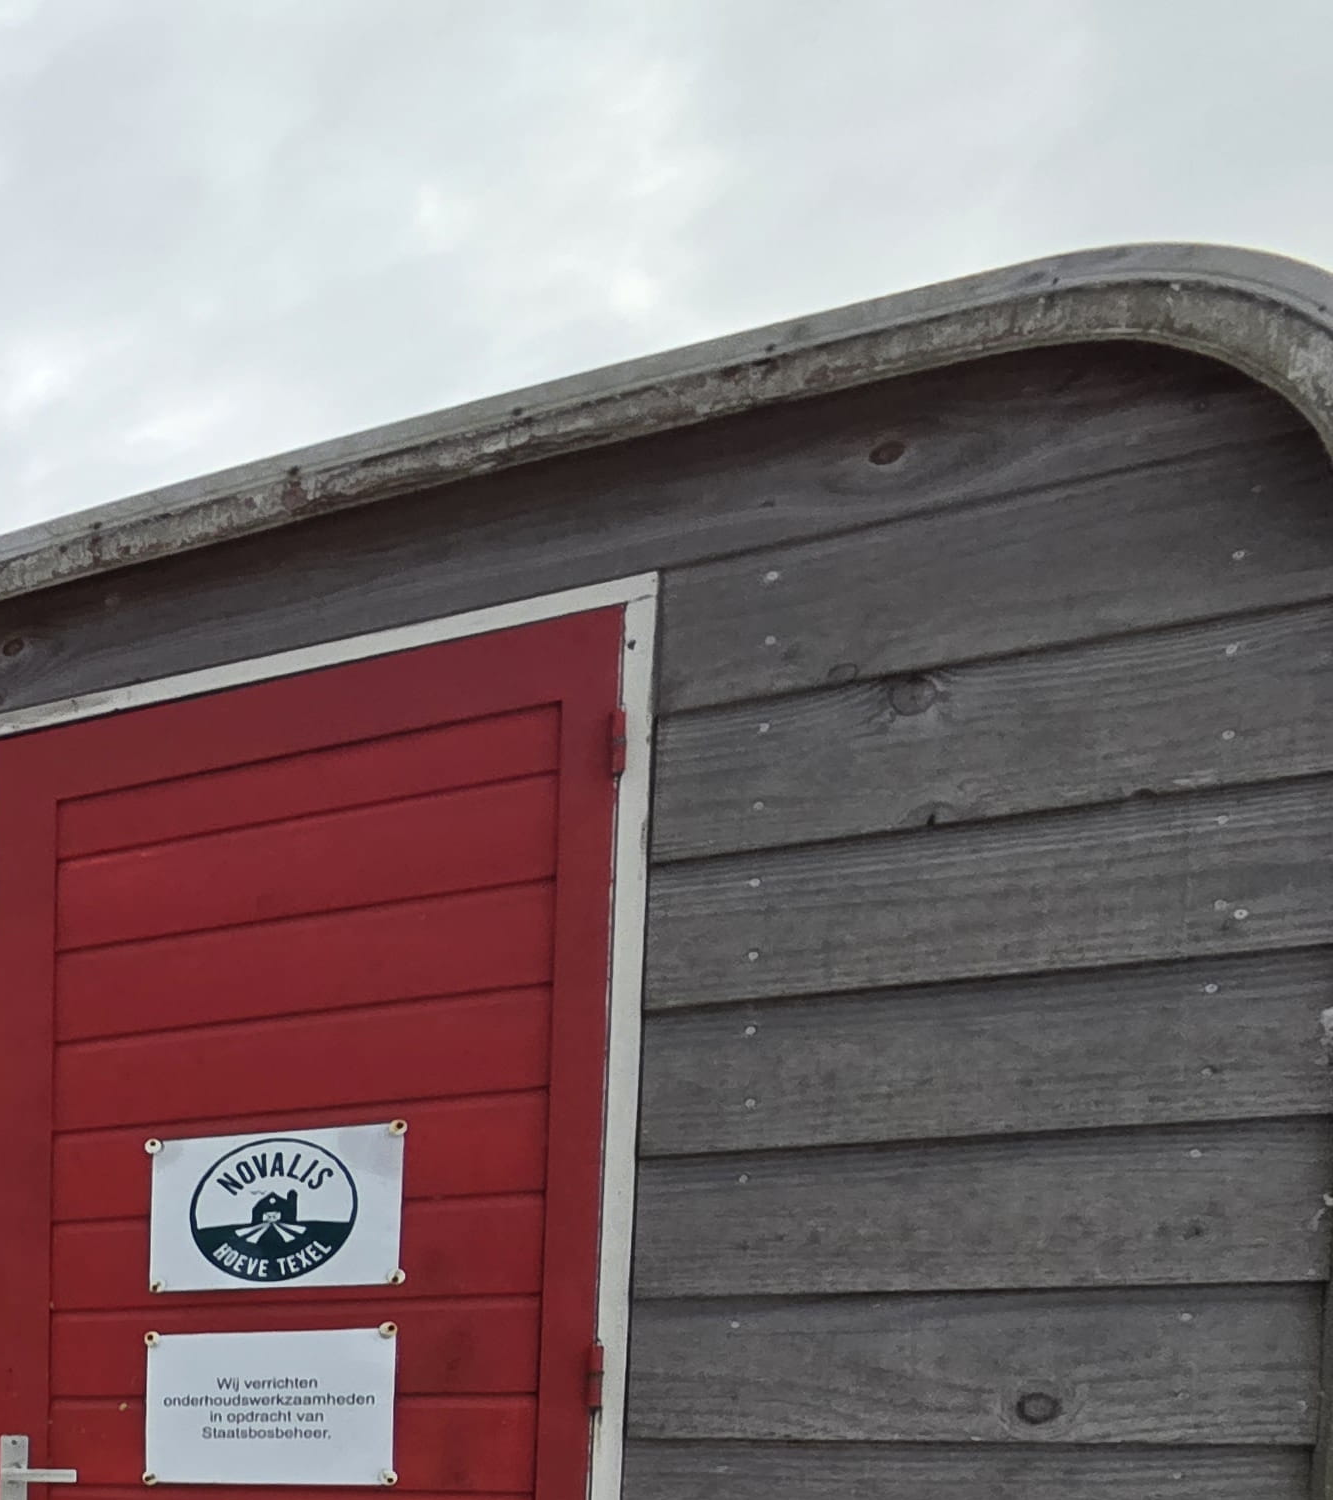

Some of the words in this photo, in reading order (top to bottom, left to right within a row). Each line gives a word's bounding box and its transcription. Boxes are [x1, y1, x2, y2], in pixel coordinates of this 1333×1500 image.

[217, 1152, 334, 1195] NOVALIS
[213, 1242, 268, 1278] HOEVE
[277, 1240, 332, 1276] TEXEL
[217, 1377, 240, 1391] Wij
[244, 1376, 318, 1389] verrichten
[163, 1393, 376, 1407] onderhoudswerkzaamheden
[210, 1410, 222, 1423] in
[227, 1410, 292, 1425] opdracht
[296, 1411, 324, 1423] van
[201, 1426, 332, 1440] Staatsbosbeheer.
